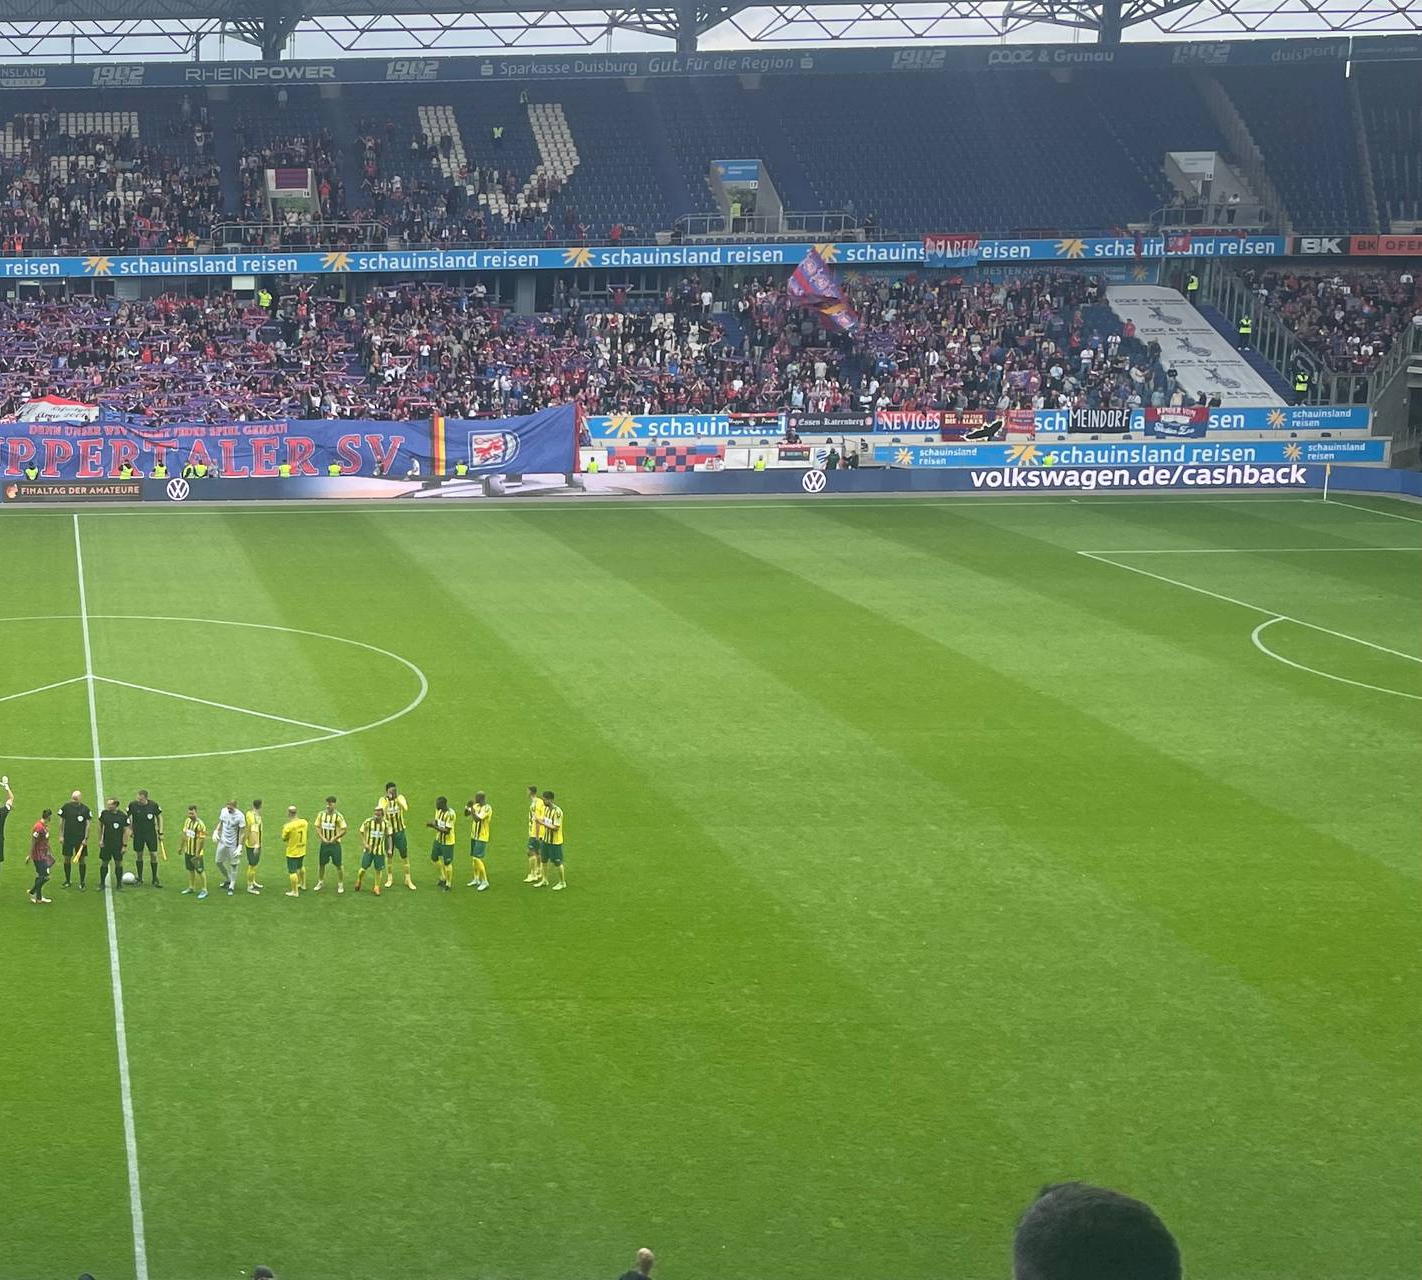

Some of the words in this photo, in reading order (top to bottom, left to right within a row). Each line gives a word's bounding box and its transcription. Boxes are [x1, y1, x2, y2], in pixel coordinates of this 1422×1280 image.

[1037, 50, 1051, 62] &
[1053, 49, 1115, 62] Grunau
[1271, 45, 1336, 62] duisport
[92, 66, 145, 79] 1902
[386, 60, 439, 73] 1902
[499, 62, 570, 77] Sparkasse
[575, 60, 638, 76] Duisburg
[649, 58, 683, 73] Gut.
[686, 57, 711, 71] Für
[714, 57, 737, 71] die
[741, 56, 794, 74] Region
[185, 66, 336, 81] RHEINPOWER
[846, 243, 926, 261] schauins
[979, 242, 1031, 258] eisen
[1219, 237, 1275, 255] reisen
[1300, 238, 1343, 253] BK
[1357, 240, 1377, 250] BK
[358, 251, 477, 270] schauinsland
[483, 250, 539, 268] reisen
[601, 246, 721, 266] schauinsland
[726, 246, 783, 263] reisen
[5, 260, 60, 275] reisen
[120, 256, 237, 274] schauinsland
[242, 255, 298, 272] reisen
[1068, 407, 1131, 429] MEINDORF
[1292, 409, 1352, 418] schauinsland
[798, 418, 821, 426] Essen
[881, 412, 941, 431] NEVIGES
[1291, 418, 1320, 427] reisen
[337, 433, 405, 476] SV
[919, 447, 978, 457] schauinsland
[1052, 444, 1185, 464] schauinsland
[1189, 445, 1256, 462] reisen
[1307, 443, 1366, 452] schauinsland
[919, 456, 947, 465] reisen
[1307, 452, 1335, 460] reisen
[971, 464, 1307, 491] volkswagen.de/cashback
[20, 486, 65, 496] FINALTAG
[67, 486, 88, 496] DER
[89, 486, 140, 495] AMATEURE
